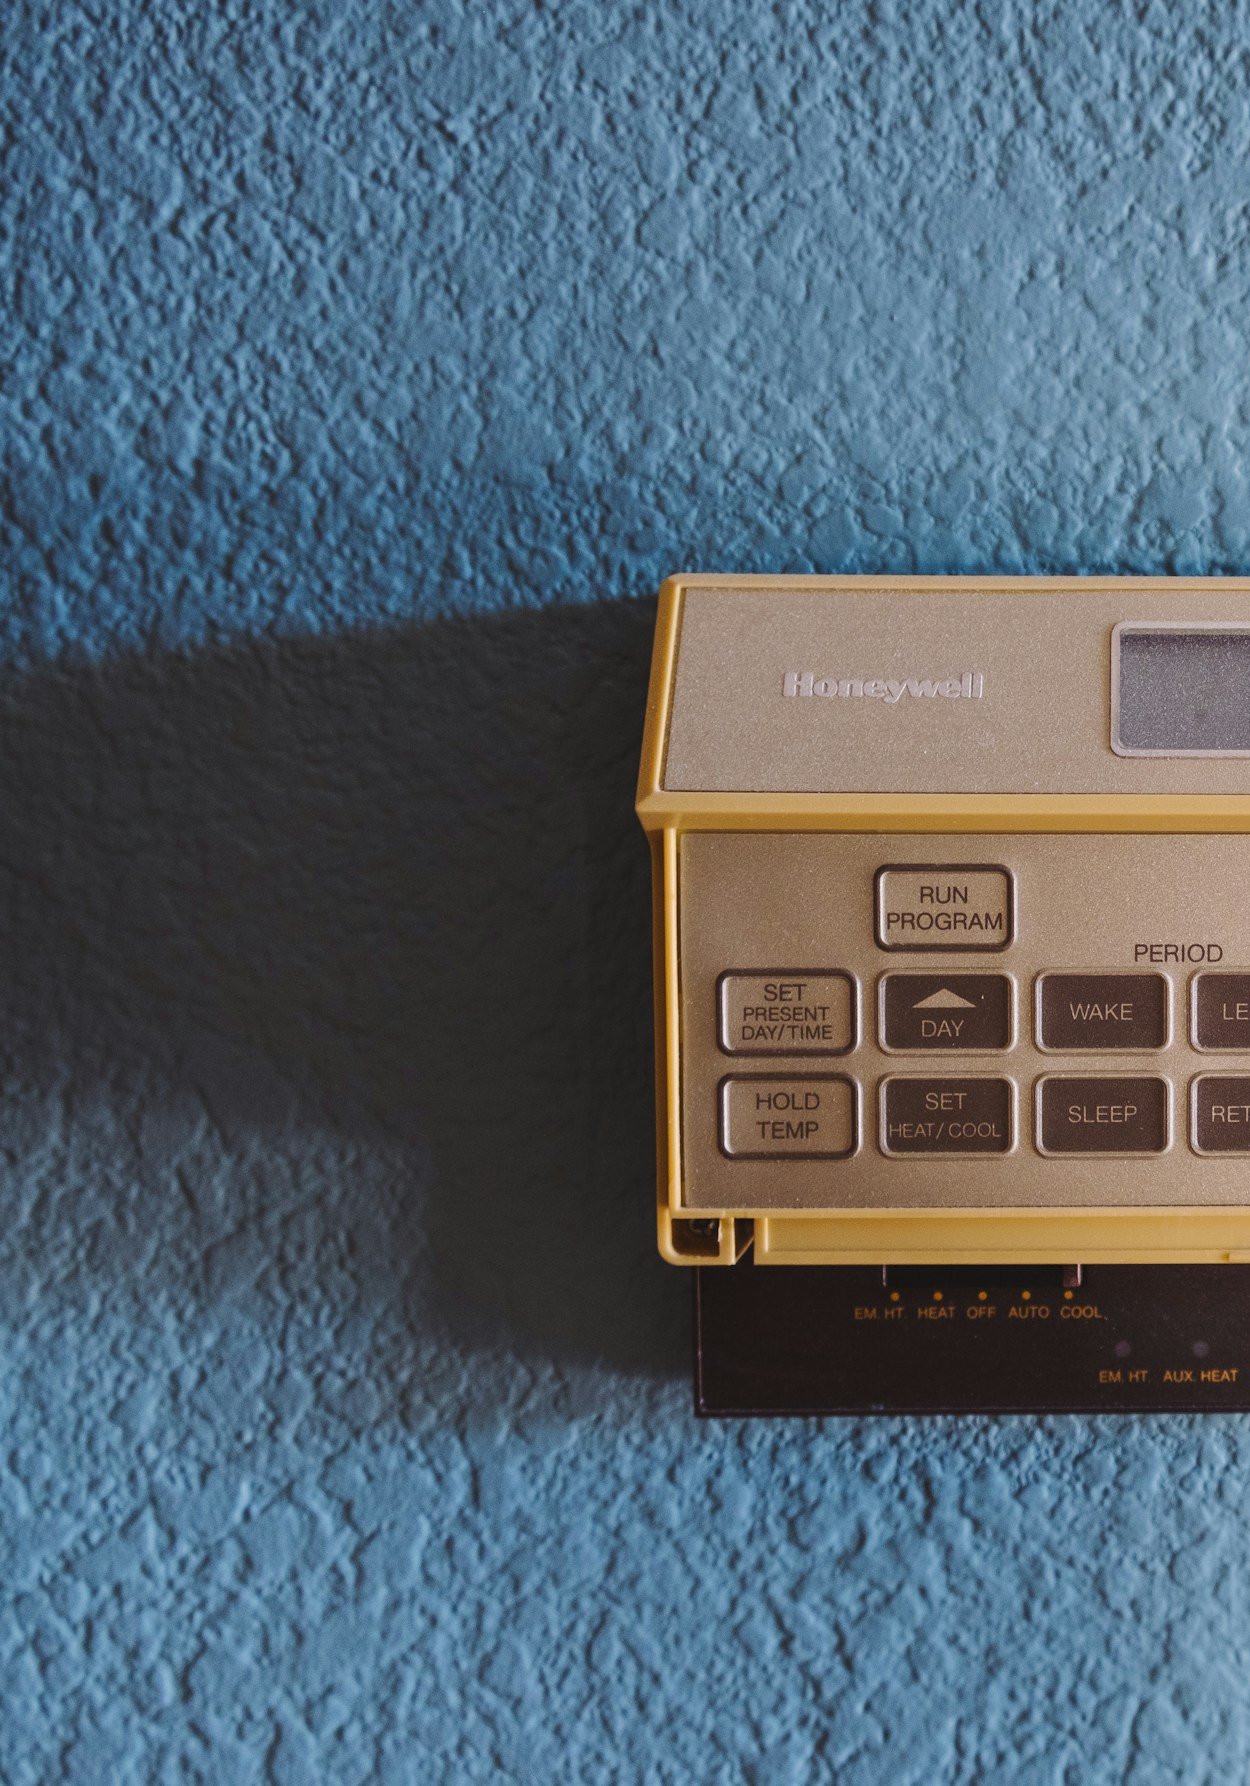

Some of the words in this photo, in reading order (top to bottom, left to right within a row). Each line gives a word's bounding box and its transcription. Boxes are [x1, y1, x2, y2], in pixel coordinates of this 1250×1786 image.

[782, 671, 984, 703] Honeywell
[918, 885, 970, 904] RUN
[886, 912, 1003, 931] PROGRAM
[1133, 944, 1224, 963] PERIOD
[763, 983, 807, 1000] SET
[742, 1005, 830, 1021] PRESENT
[1069, 1002, 1134, 1020] WAKE
[741, 1024, 833, 1041] DAY/TIME
[920, 1019, 965, 1037] DAY
[755, 1093, 820, 1110] HOLD
[924, 1092, 969, 1109] SET
[1067, 1104, 1138, 1122] SLEEP
[756, 1121, 820, 1139] TEMP
[917, 1306, 957, 1321] HEAT
[966, 1306, 997, 1321] OFF
[1007, 1306, 1051, 1321] AUTO
[1059, 1306, 1103, 1321] COOL
[1200, 1369, 1239, 1385] HEAT
